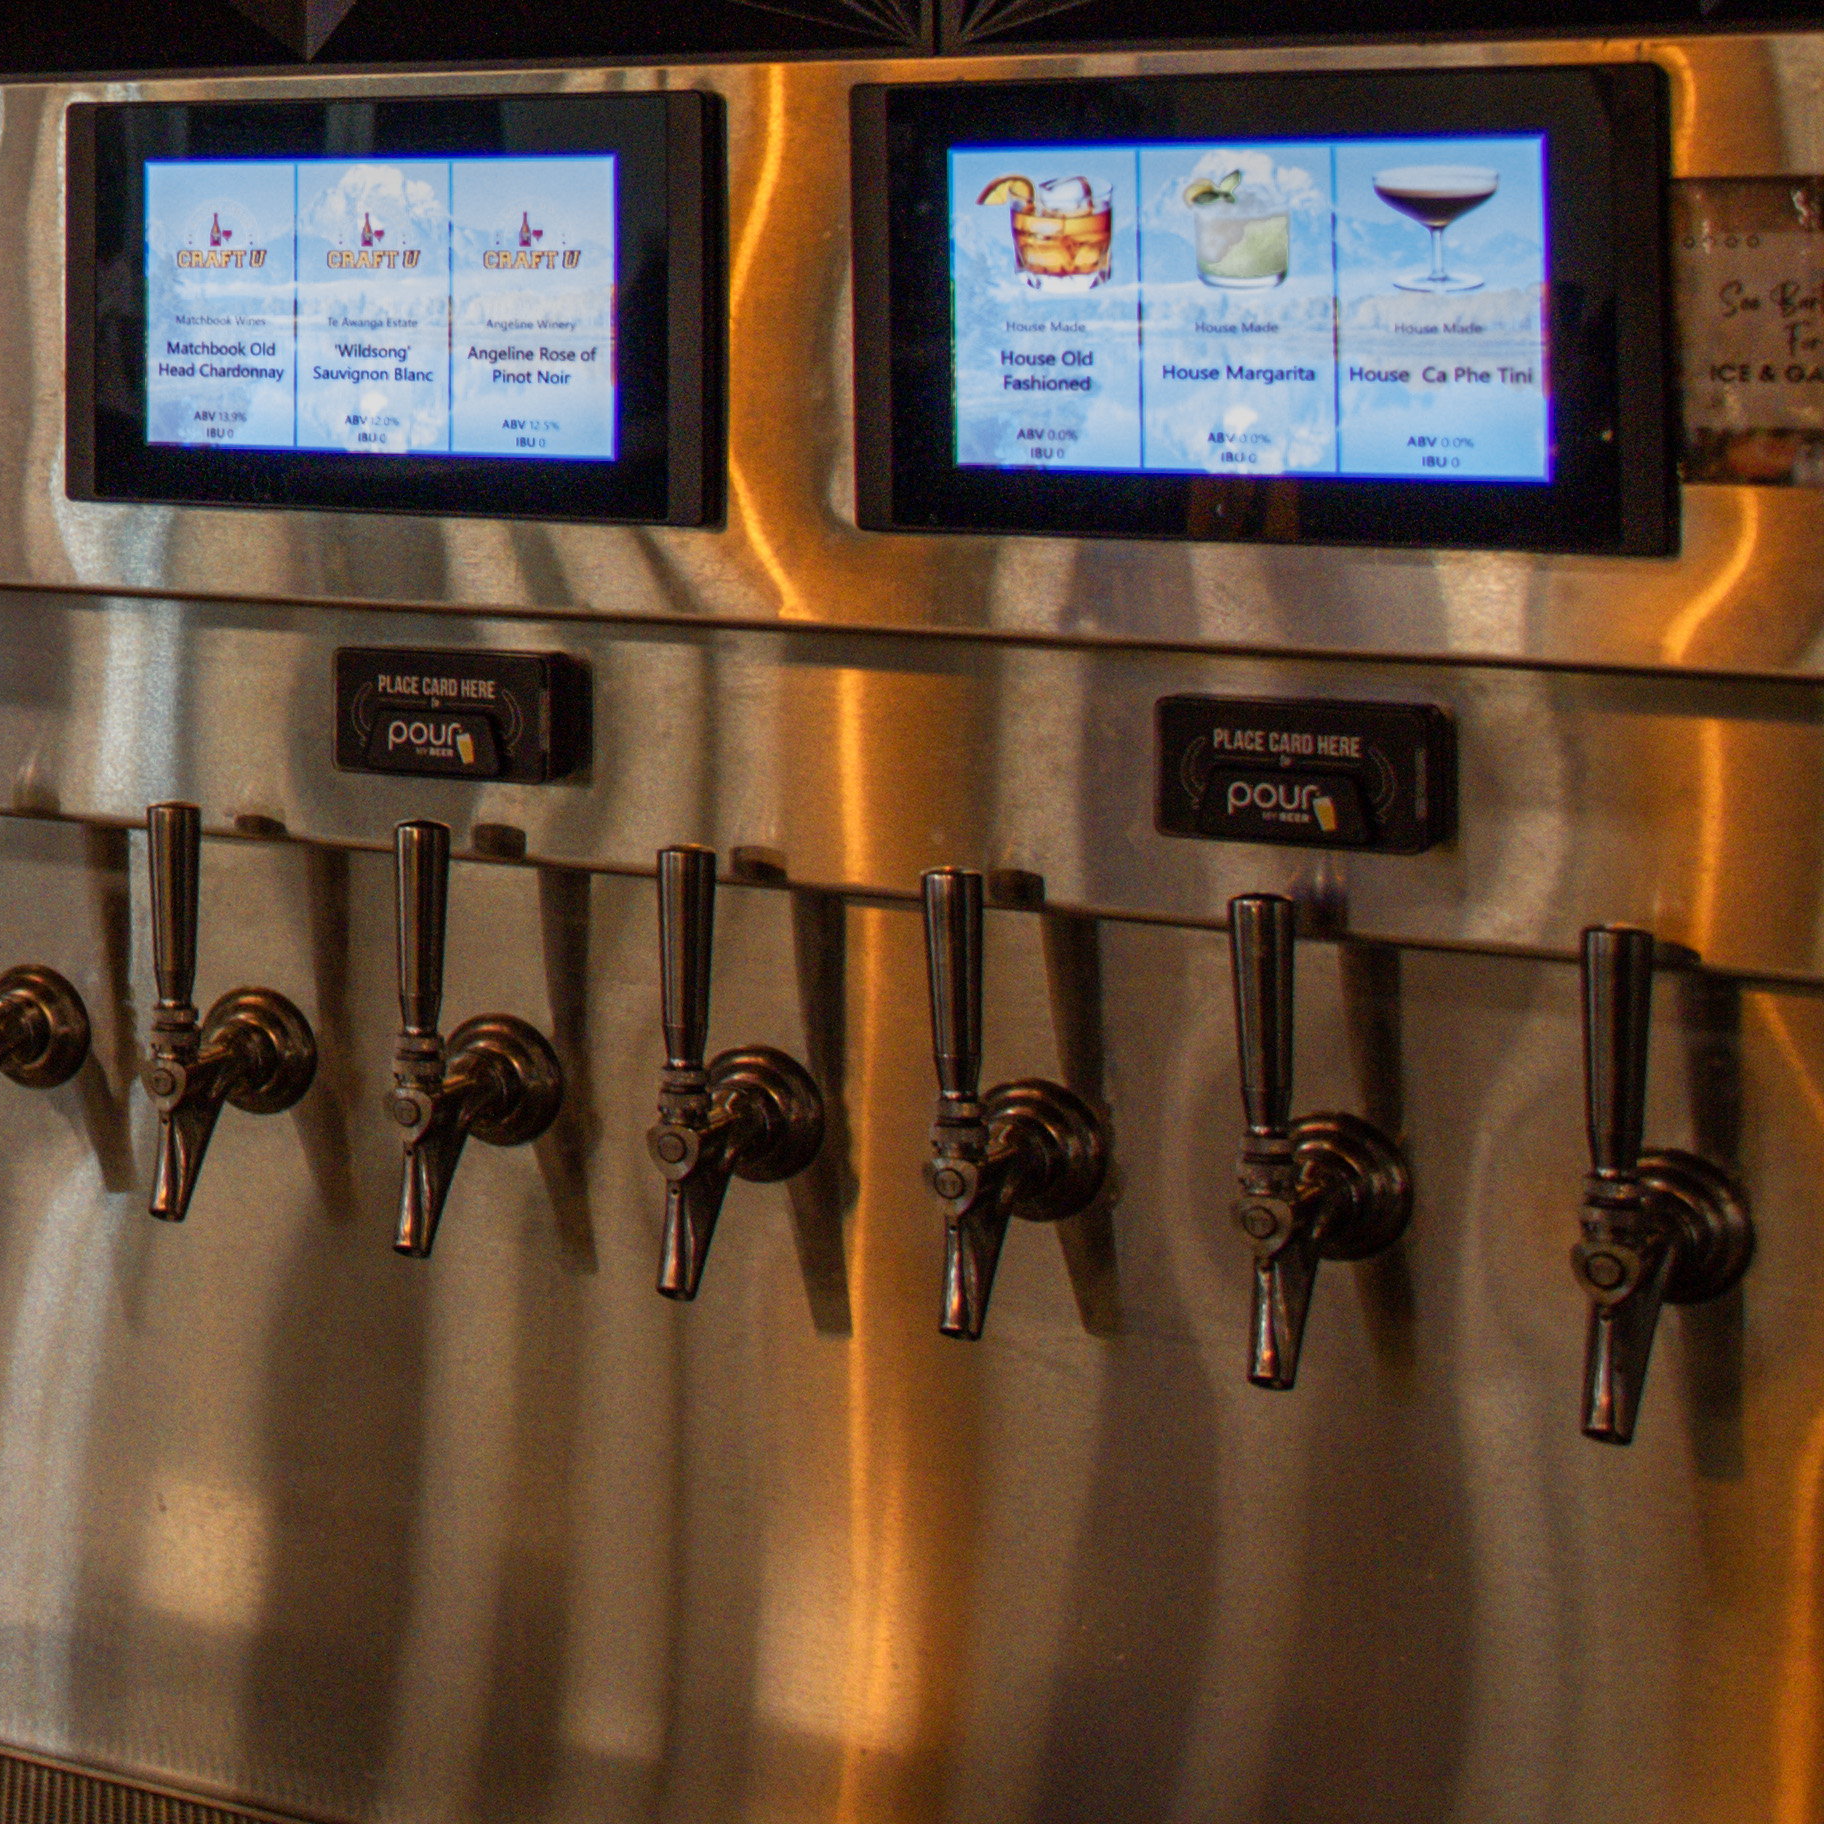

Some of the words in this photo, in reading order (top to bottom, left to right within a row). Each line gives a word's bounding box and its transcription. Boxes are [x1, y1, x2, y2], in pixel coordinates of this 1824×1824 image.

[177, 249, 246, 268] CRAFT
[249, 249, 267, 268] U
[327, 250, 399, 269] CRAFT
[402, 250, 421, 269] U
[483, 250, 558, 269] CRAFT
[562, 250, 581, 269] U
[175, 315, 231, 326] Matchbook
[235, 316, 266, 326] Wines
[327, 317, 339, 327] Te
[341, 318, 383, 329] Awanga
[386, 318, 418, 328] Estate
[486, 319, 533, 331] Angeline
[536, 320, 576, 331] Winery
[1006, 322, 1044, 332] House
[1050, 322, 1086, 333] Made
[1195, 322, 1237, 334] House
[1241, 323, 1279, 334] Made
[1395, 323, 1438, 335] House
[1442, 323, 1483, 335] Made
[166, 341, 245, 356] Matchbook
[249, 342, 276, 356] Old
[334, 344, 412, 362] 'Wildsong'
[468, 346, 534, 363] Angeline
[539, 347, 576, 361] Rose
[580, 346, 598, 362] of
[1001, 350, 1056, 366] House
[1061, 351, 1093, 366] Old
[158, 362, 195, 377] Head
[199, 363, 284, 382] Chardonnay
[313, 366, 388, 383] Sauvignon
[394, 368, 434, 382] Blanc
[492, 370, 532, 384] Pinot
[537, 370, 571, 384] Noir
[1162, 365, 1219, 381] House
[1226, 366, 1316, 385] Margarita
[1349, 367, 1410, 383] House
[1422, 366, 1448, 384] Ca
[1454, 367, 1491, 384] Phe
[1496, 367, 1534, 384] Tini
[1711, 363, 1750, 382] ICE
[1758, 363, 1775, 382] &
[1003, 375, 1091, 391] Fashioned
[194, 411, 216, 422] ABV
[218, 411, 247, 423] 13.9%
[345, 415, 367, 426] ABV
[502, 419, 525, 430] ABV
[206, 428, 225, 439] IBU
[358, 432, 376, 443] IBU
[1017, 429, 1044, 441] ABV
[1047, 429, 1078, 442] 0.0%
[1207, 432, 1235, 444] ABV
[516, 437, 535, 447] IBU
[1407, 436, 1436, 448] ABV
[1441, 437, 1474, 449] 0.0%
[1030, 448, 1052, 459] IBU
[1056, 448, 1064, 459] 0
[1220, 452, 1244, 463] IBU
[1422, 456, 1447, 468] IBU
[1451, 457, 1460, 468] 0
[378, 674, 419, 695] PLACE
[422, 677, 457, 696] CARD
[461, 679, 495, 699] HERE
[388, 721, 462, 751] pour
[1213, 728, 1265, 751] PLACE
[1269, 732, 1313, 755] CARD
[1317, 735, 1361, 758] HERE
[1227, 781, 1320, 815] pour
